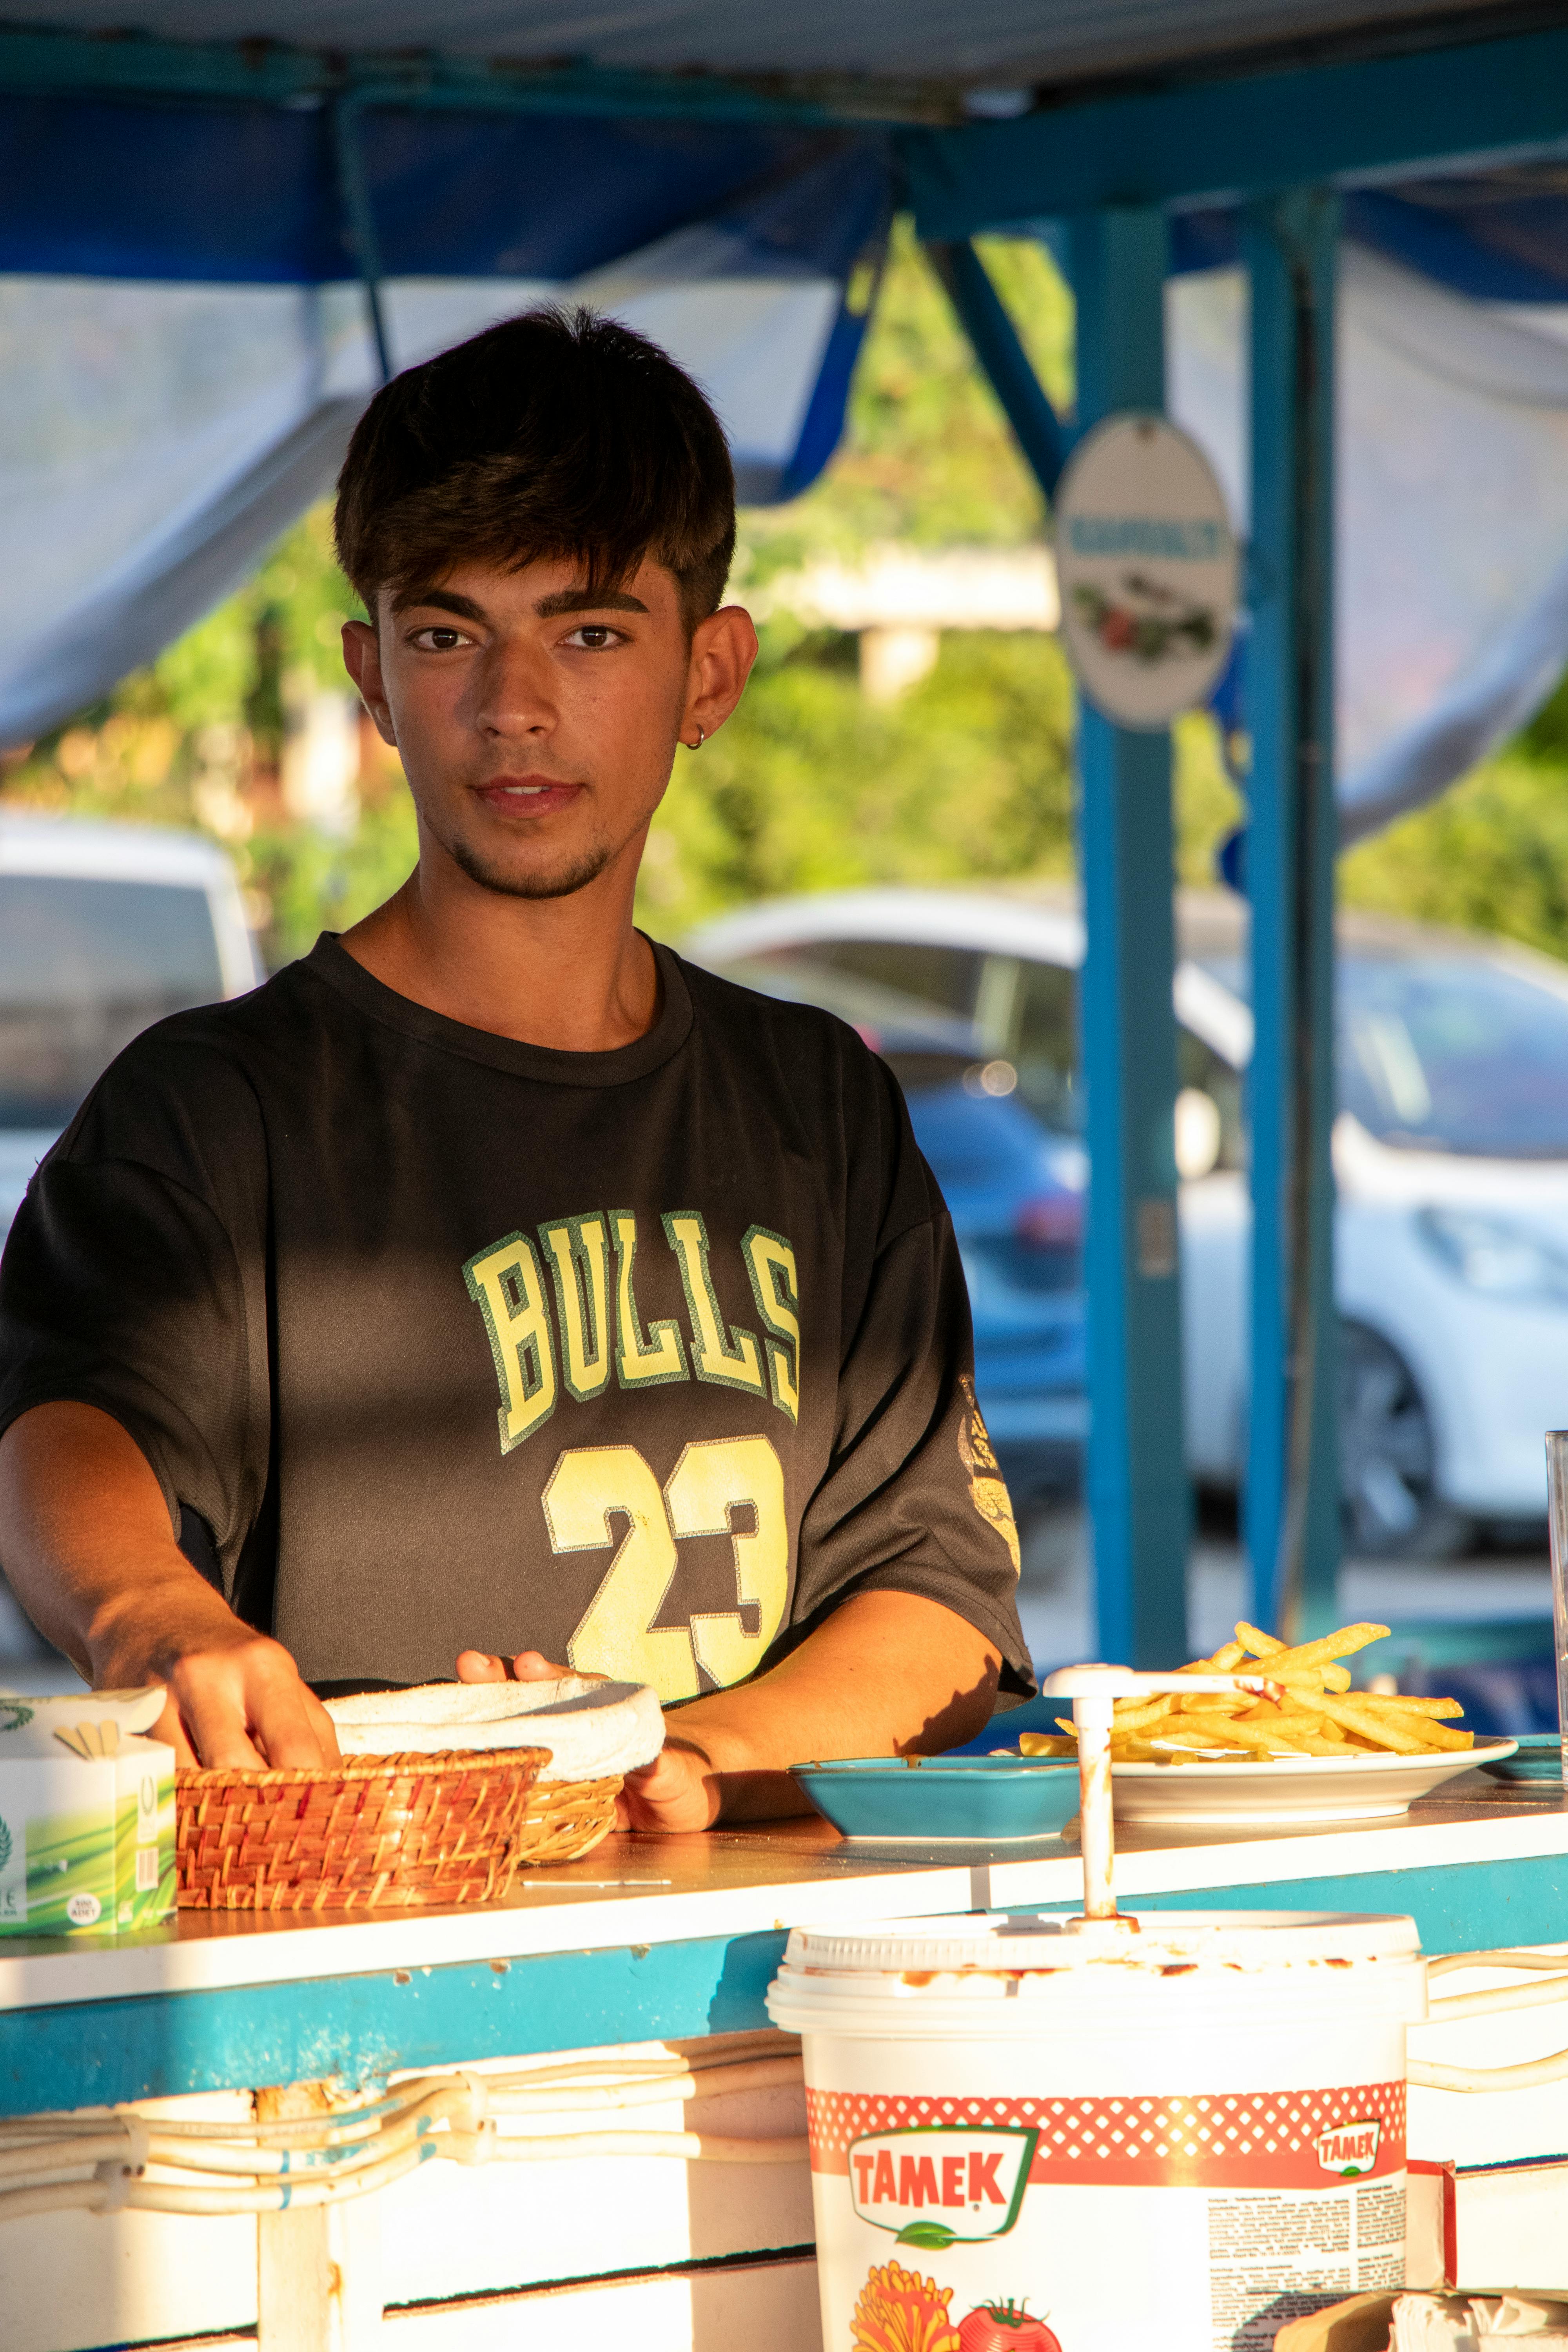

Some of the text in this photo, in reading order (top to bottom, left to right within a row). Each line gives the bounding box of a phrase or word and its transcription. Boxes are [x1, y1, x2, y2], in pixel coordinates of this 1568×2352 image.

[462, 1210, 800, 1455] BULLS
[541, 1434, 788, 1704] 23
[853, 2150, 1007, 2207] TAMEK
[1321, 2132, 1374, 2163] TAMEK
